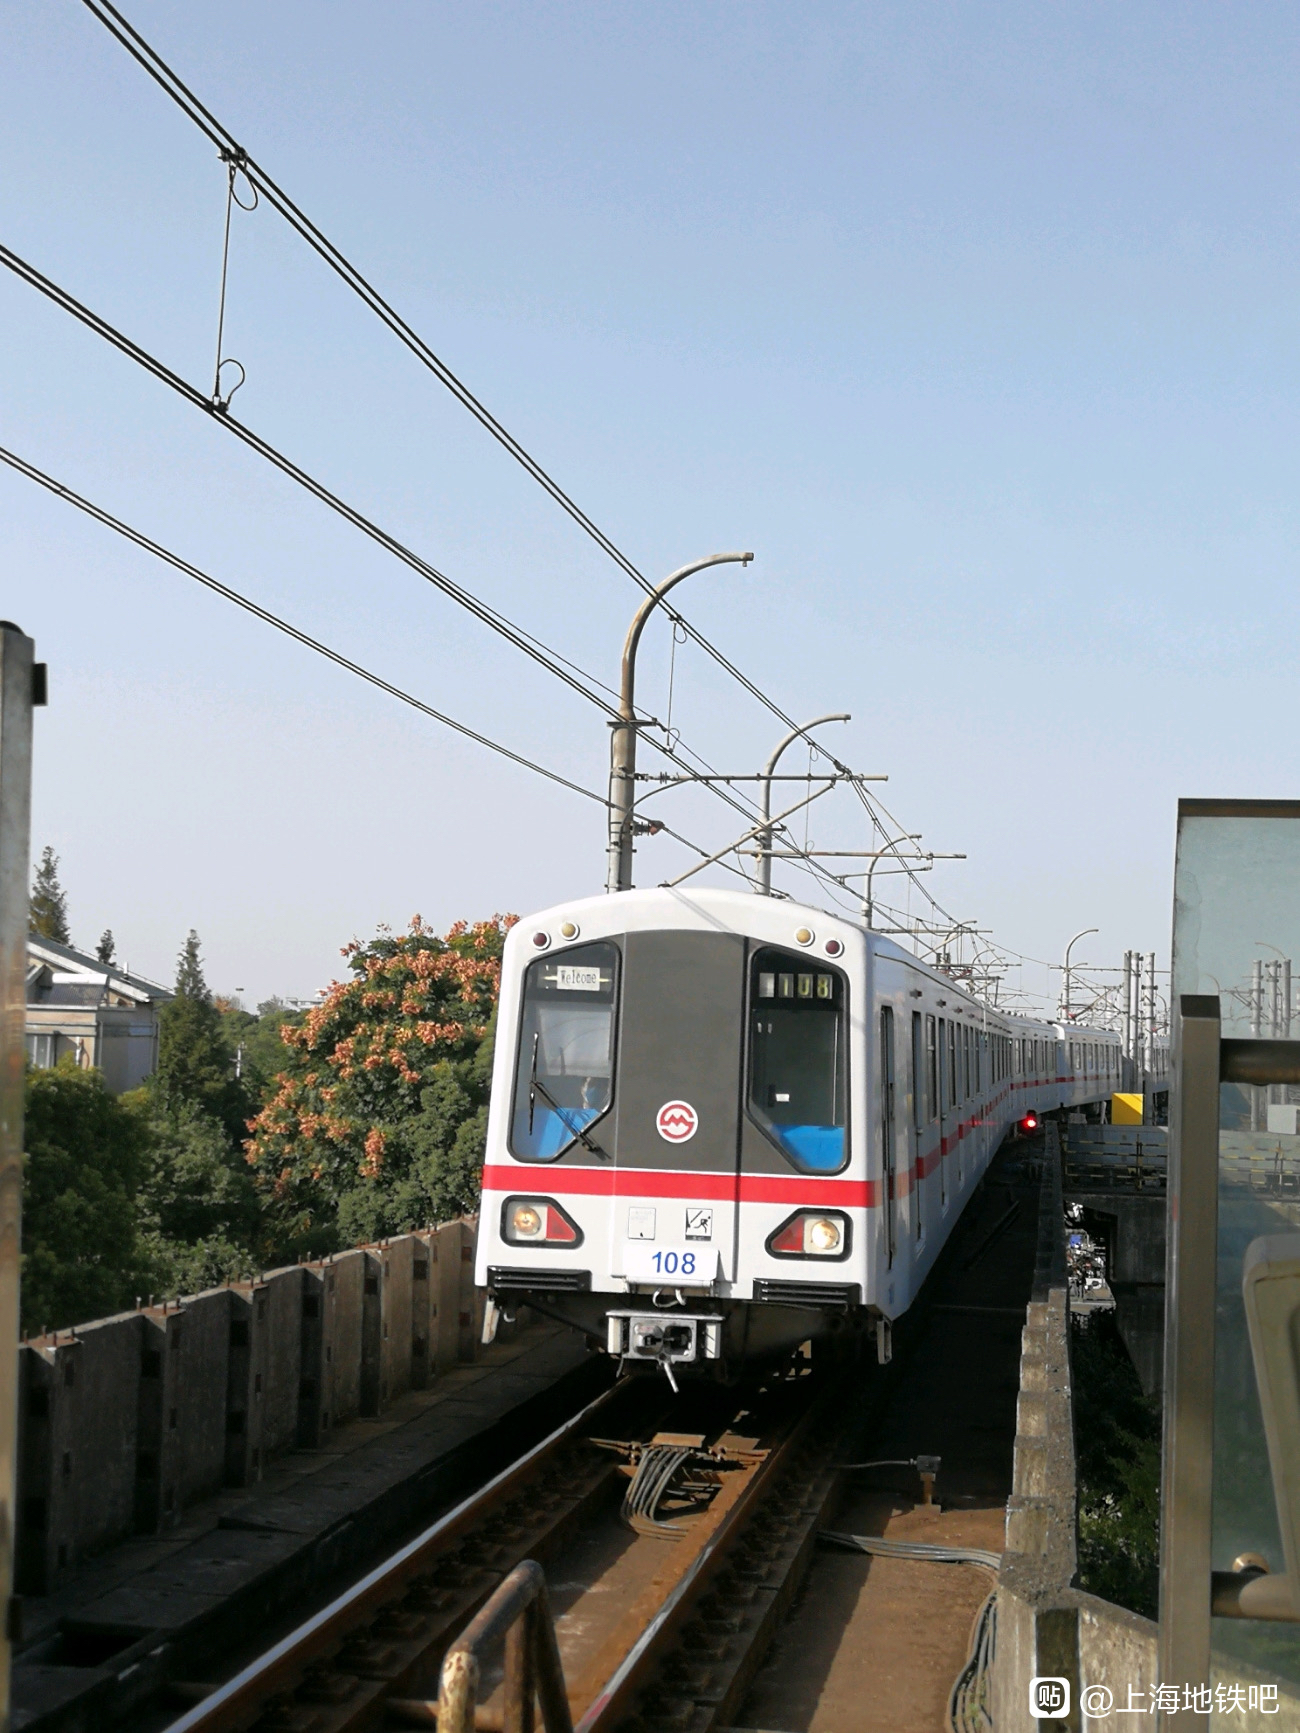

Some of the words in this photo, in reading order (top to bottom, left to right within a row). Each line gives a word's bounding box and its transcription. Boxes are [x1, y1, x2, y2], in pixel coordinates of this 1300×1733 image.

[560, 969, 597, 985] Welcome
[783, 976, 829, 998] 108
[652, 1251, 696, 1275] 108
